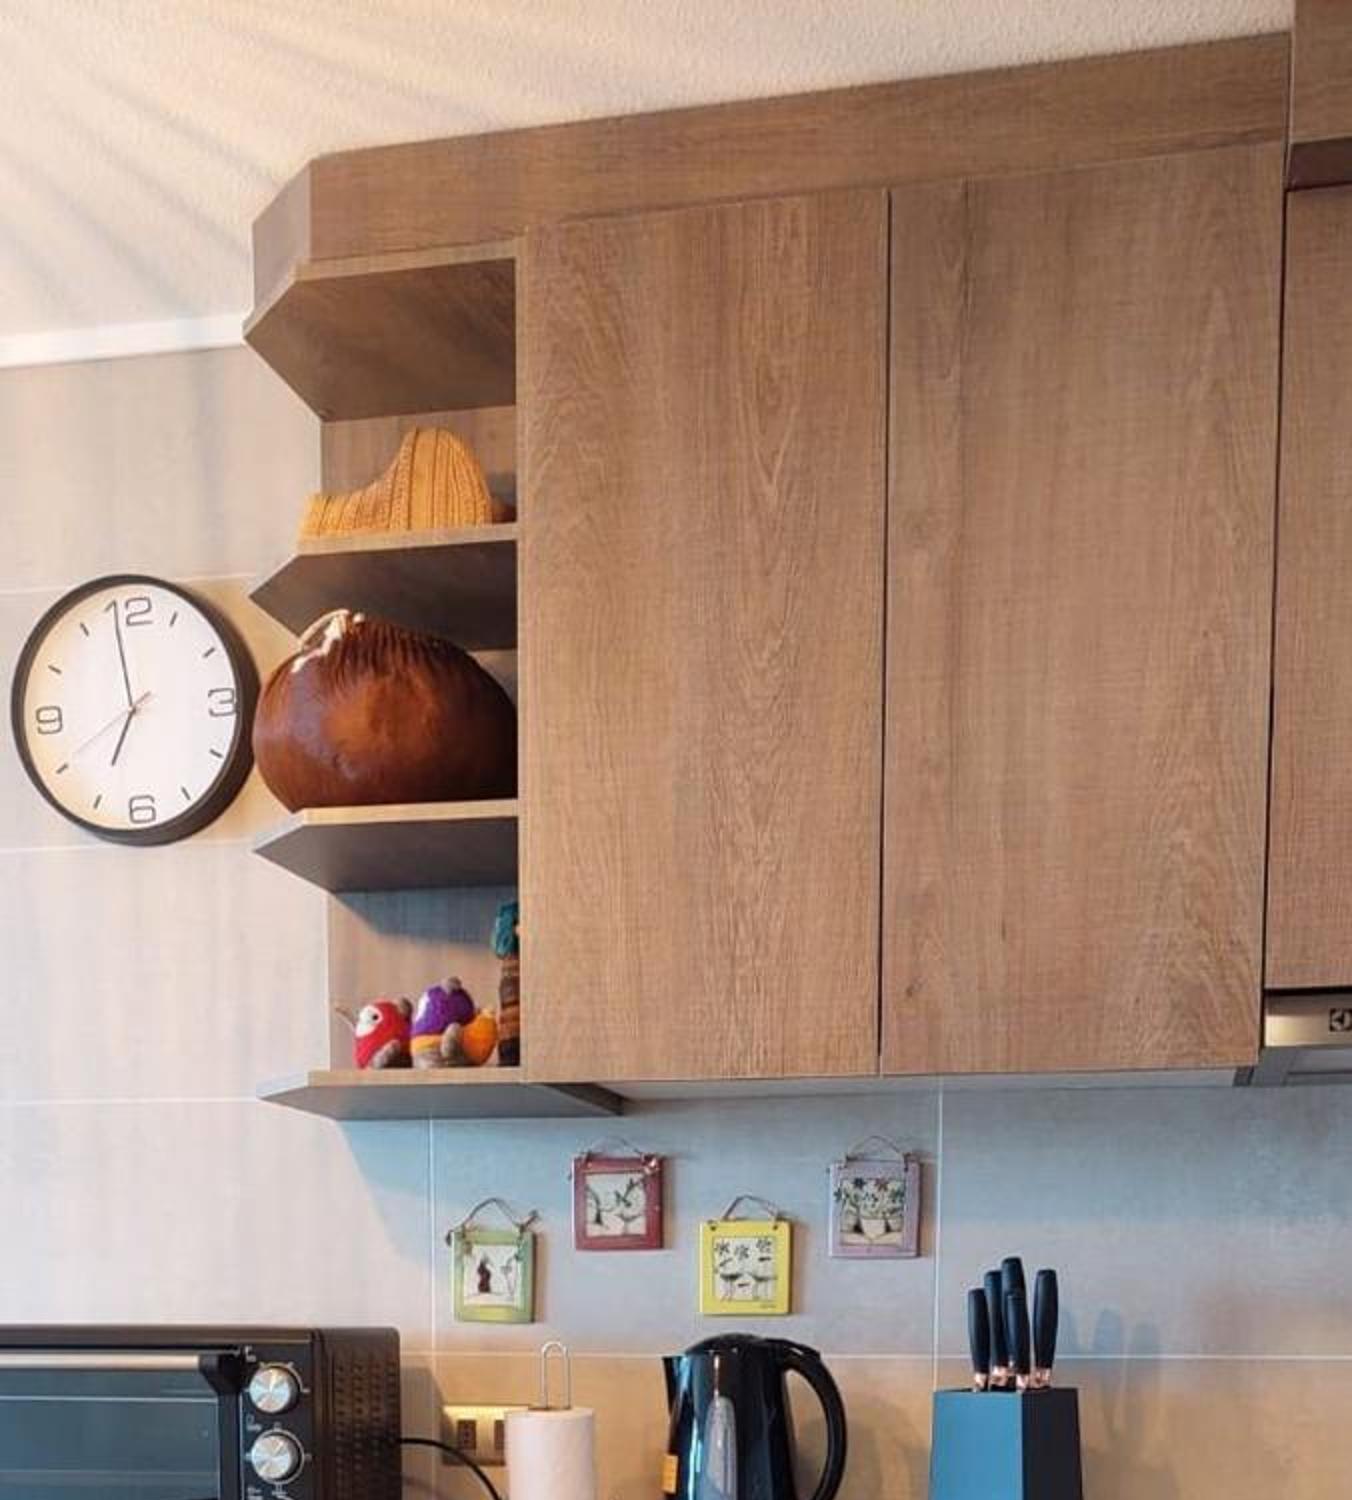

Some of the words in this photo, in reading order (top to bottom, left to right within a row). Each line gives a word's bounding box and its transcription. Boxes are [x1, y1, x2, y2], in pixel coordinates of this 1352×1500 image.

[208, 687, 236, 717] 3
[35, 705, 63, 734] 9
[128, 795, 156, 824] 6
